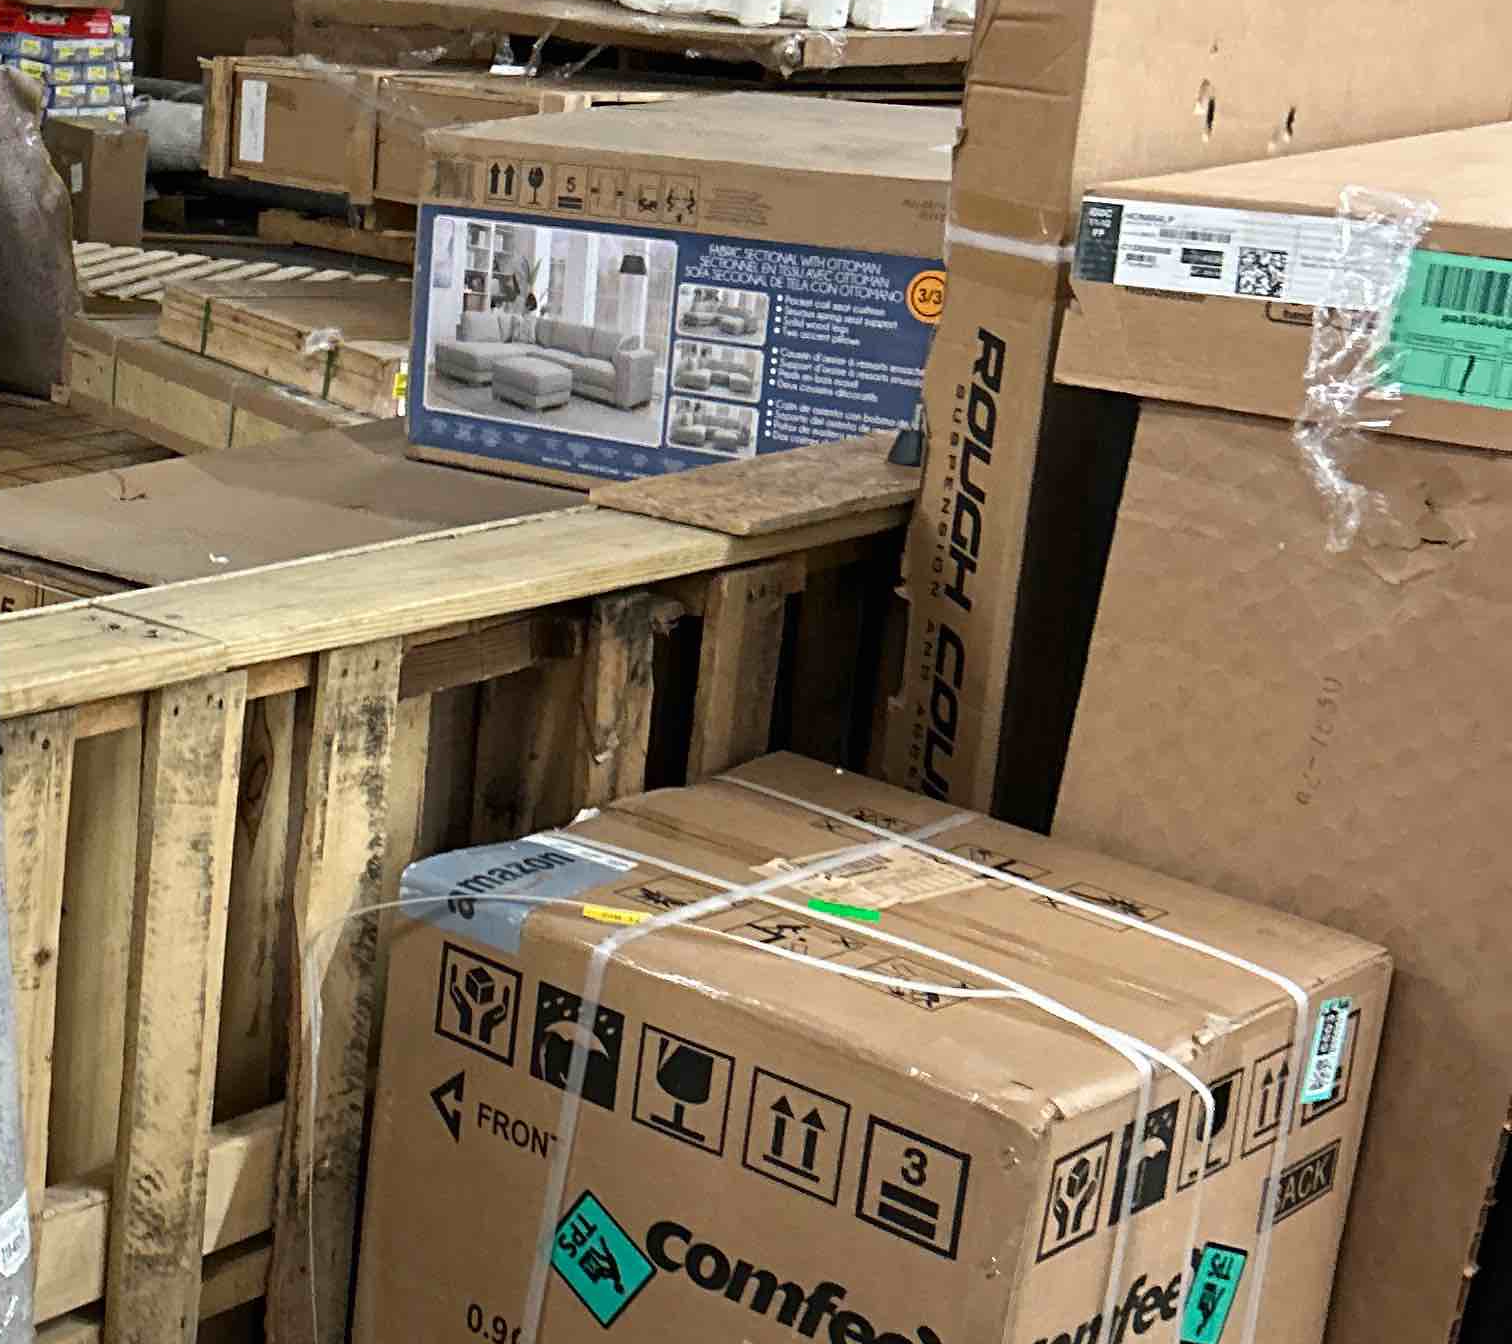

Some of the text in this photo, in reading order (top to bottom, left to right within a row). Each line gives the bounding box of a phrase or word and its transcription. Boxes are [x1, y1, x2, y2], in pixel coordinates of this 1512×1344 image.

[917, 287, 945, 305] 3/3
[922, 324, 1007, 803] ROUGH COU
[447, 850, 576, 920] amazon
[476, 1101, 559, 1161] FRON
[900, 1147, 929, 1188] 3
[1275, 1156, 1332, 1214] ACK
[555, 1213, 598, 1259] TPS
